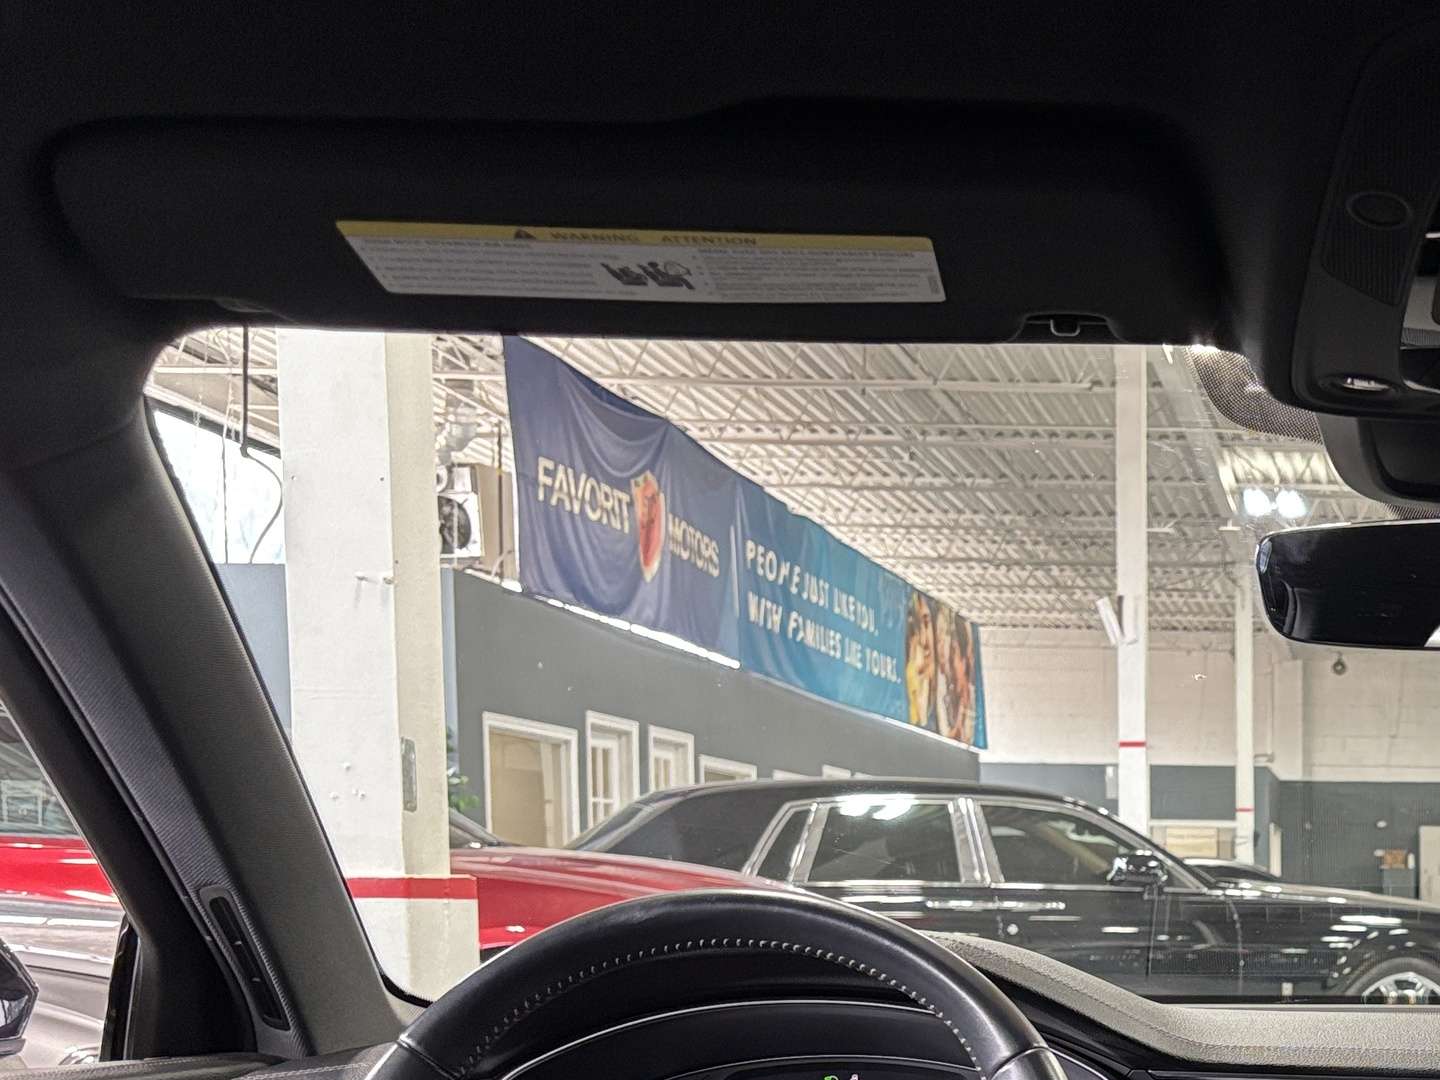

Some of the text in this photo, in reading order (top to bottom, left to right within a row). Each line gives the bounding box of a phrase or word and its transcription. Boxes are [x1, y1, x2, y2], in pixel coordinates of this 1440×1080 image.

[551, 232, 757, 245] WARNING ATTENTION
[538, 456, 720, 578] FAVORIT MOTORS
[748, 591, 782, 634] WITH
[787, 611, 842, 659] FAMILIES
